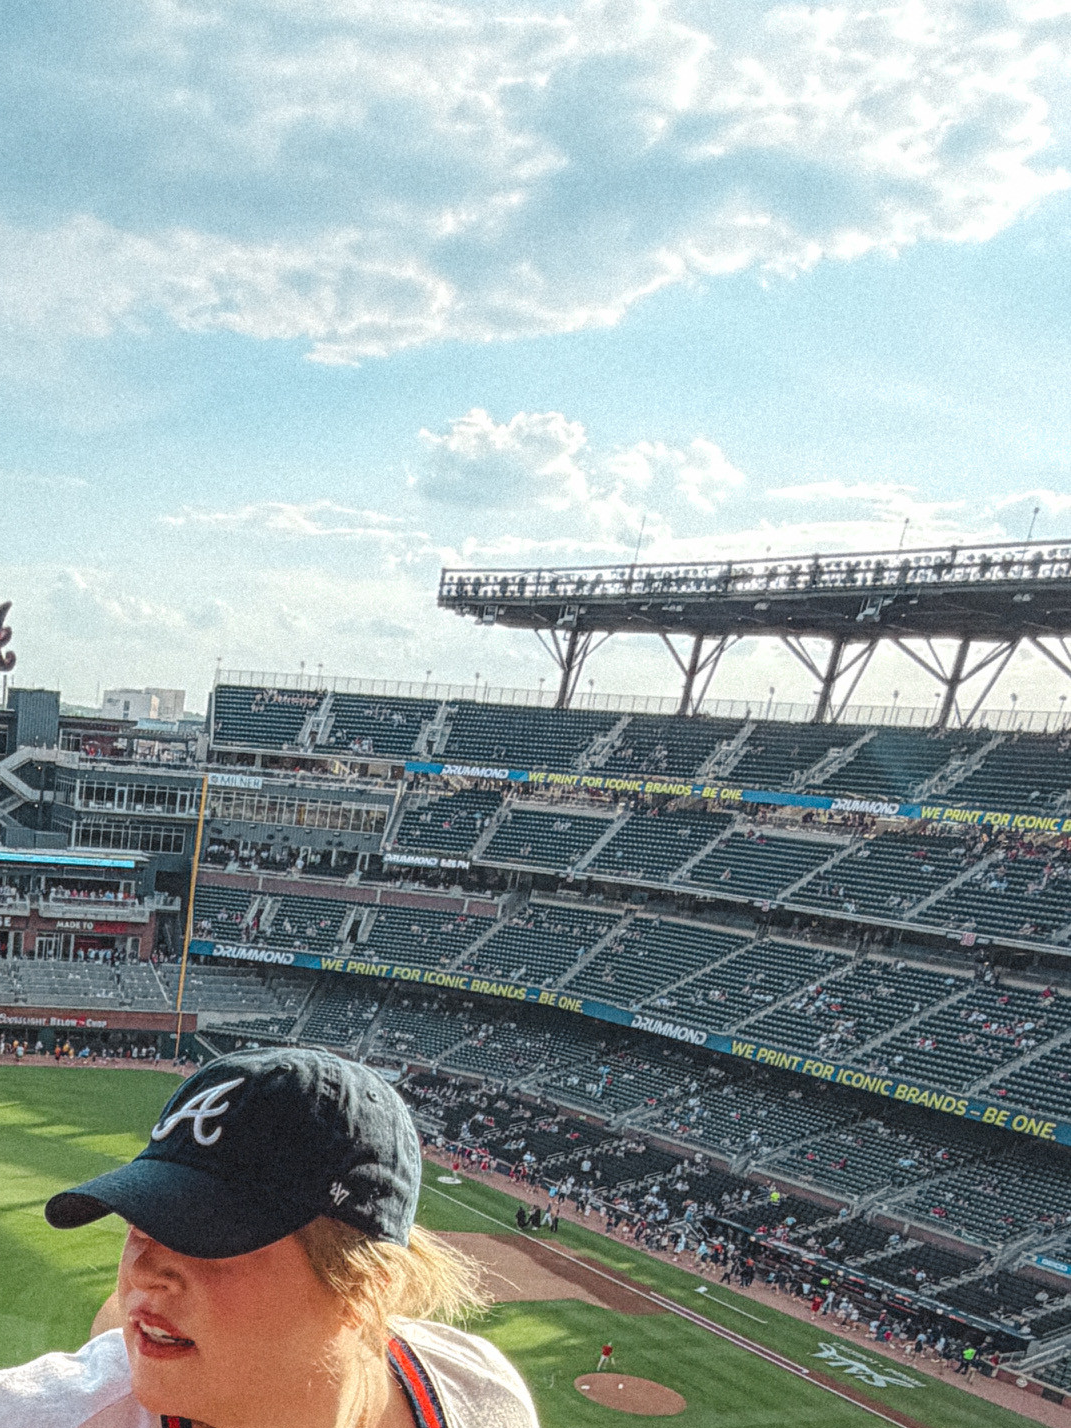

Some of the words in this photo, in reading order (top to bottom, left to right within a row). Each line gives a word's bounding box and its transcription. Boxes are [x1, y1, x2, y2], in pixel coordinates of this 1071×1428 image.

[222, 775, 261, 789] MILNER
[441, 765, 509, 780] DRUMMOND
[529, 771, 546, 783] WE
[547, 772, 580, 786] PRINT
[581, 776, 603, 788] FOR
[605, 777, 643, 792] ICONIC
[645, 780, 692, 796] BRANDS
[702, 786, 718, 798] BE
[831, 798, 899, 815] DRUMMOND
[921, 806, 940, 820] WE
[942, 808, 983, 823] PRINT
[983, 811, 1011, 827] FOR
[1012, 813, 1061, 832] ICONIC
[384, 853, 439, 866] DRUMMOND
[56, 920, 81, 929] MADE
[83, 921, 94, 930] TO
[212, 944, 295, 965] DRUMMOND
[321, 957, 344, 972] WE
[345, 960, 391, 977] PRINT
[392, 965, 422, 981] FOR
[423, 971, 470, 990] ICONIC
[471, 978, 528, 1000] BRANDS
[538, 991, 558, 1006] BE
[631, 1014, 708, 1046] DRUMMOND
[730, 1040, 756, 1058] WE
[757, 1047, 802, 1071] PRINT
[803, 1060, 834, 1079] FOR
[836, 1068, 893, 1097] ICONIC
[893, 1083, 969, 1116] BRANDS
[982, 1107, 1010, 1127] BE
[151, 1077, 245, 1146] A
